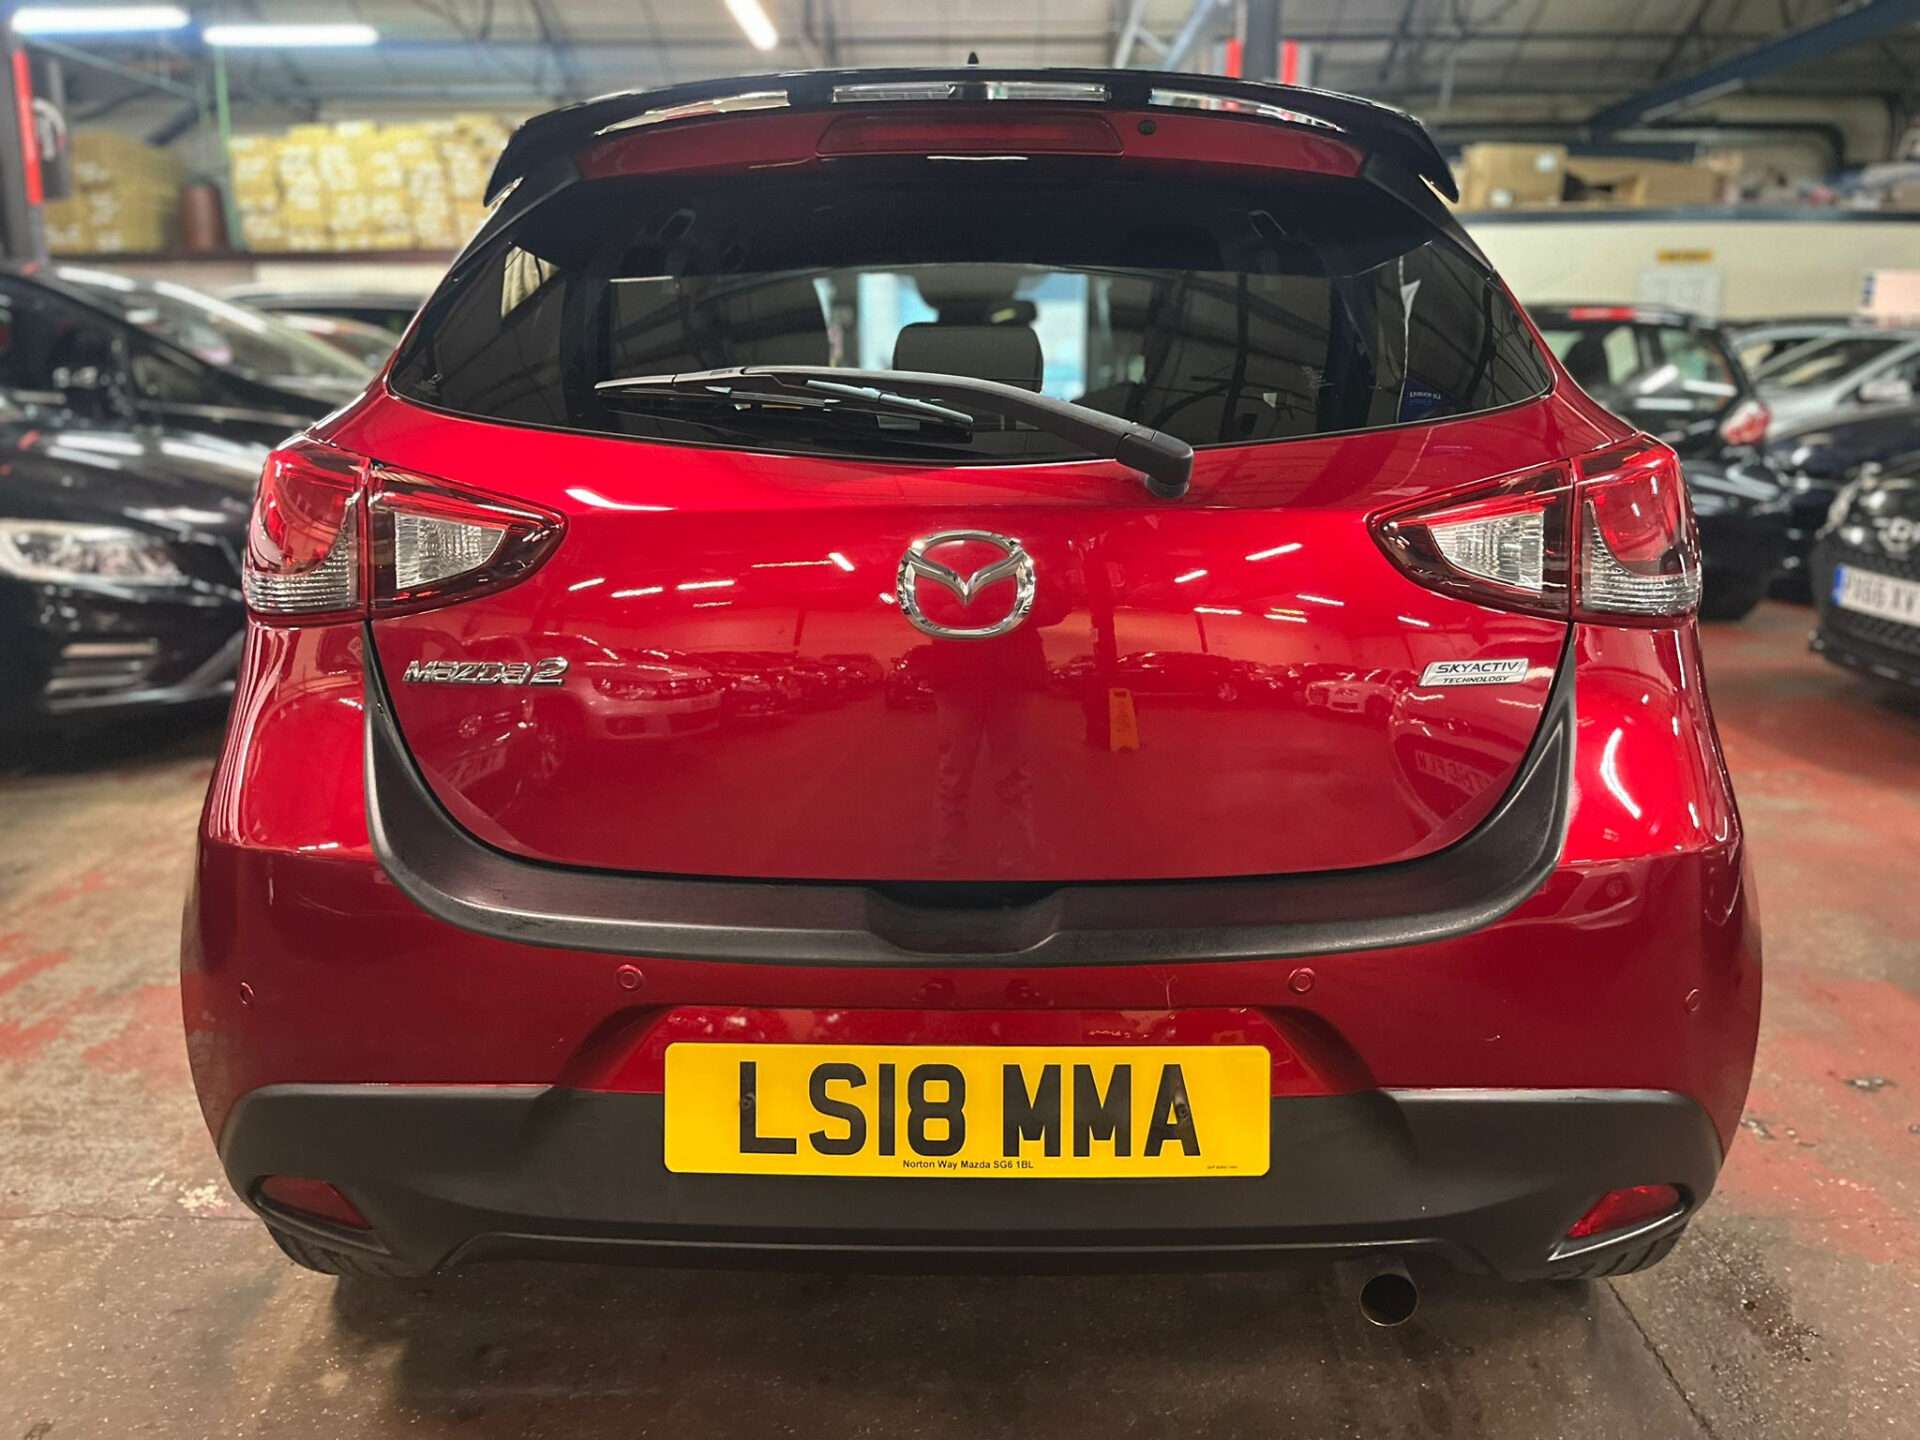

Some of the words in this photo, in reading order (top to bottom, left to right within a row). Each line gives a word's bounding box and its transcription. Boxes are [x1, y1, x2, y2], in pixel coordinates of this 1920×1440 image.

[1435, 661, 1519, 674] SKYACTIV
[1443, 675, 1509, 684] TECHNOLOGY
[739, 1061, 966, 1156] LS18
[1002, 1064, 1200, 1157] MMA
[903, 1160, 935, 1169] Norton
[938, 1160, 958, 1171] Way
[960, 1160, 991, 1169] Mazda
[993, 1160, 1013, 1169] SG6
[1016, 1160, 1034, 1169] 1BL
